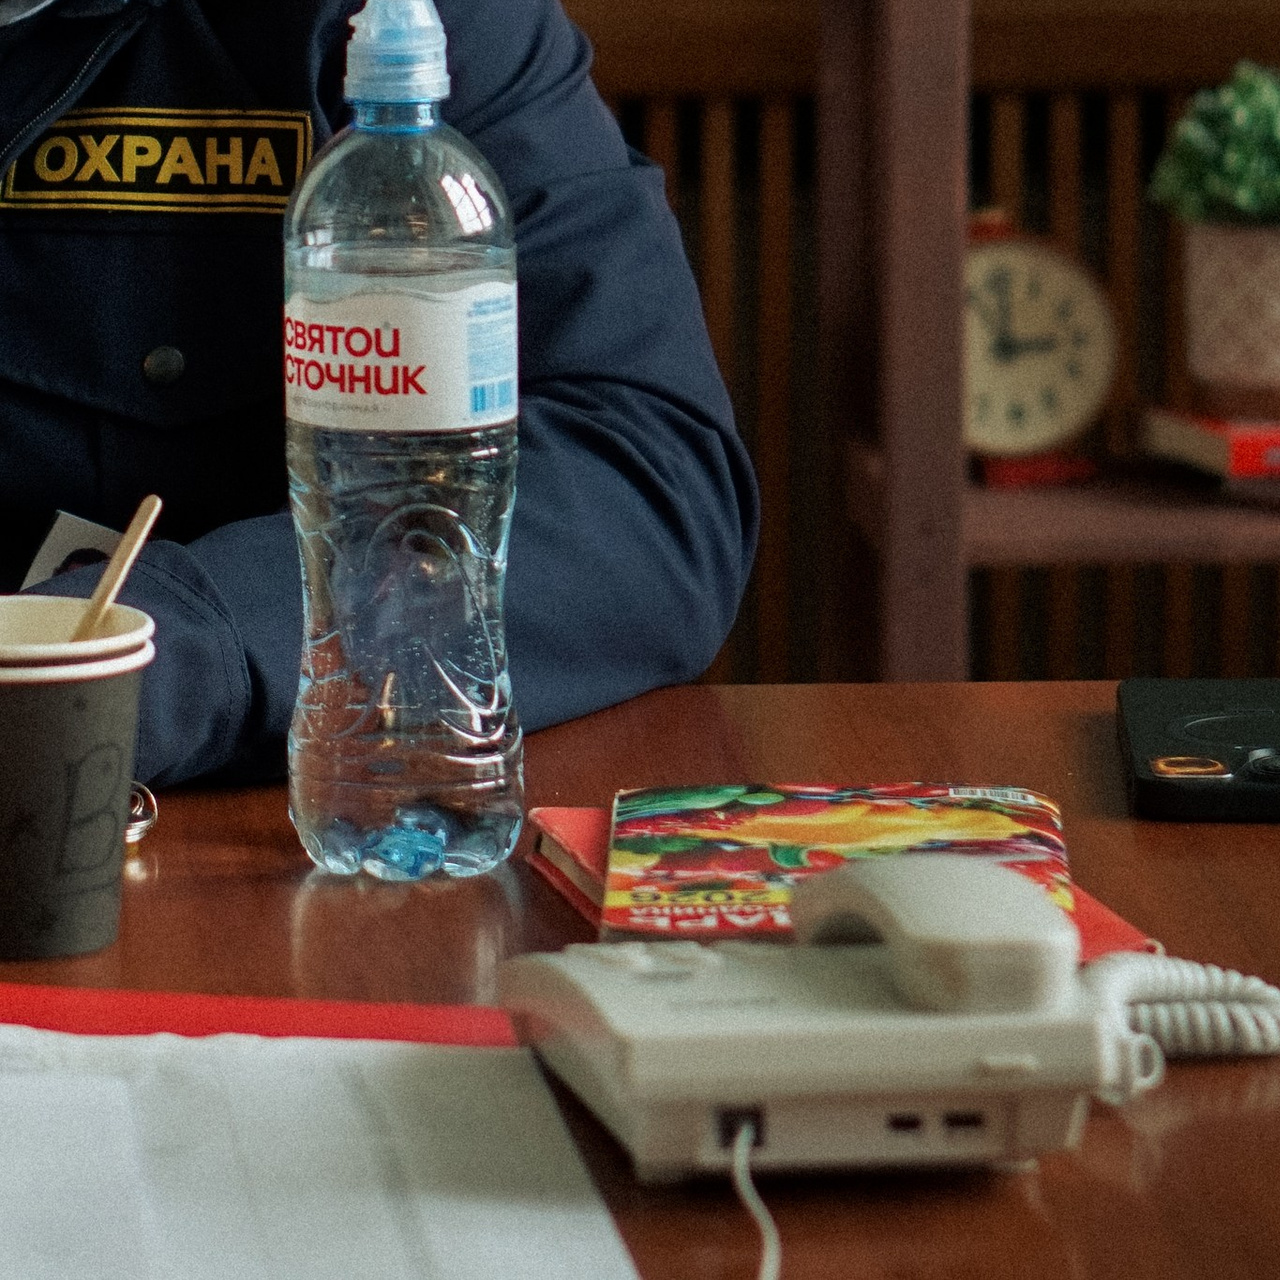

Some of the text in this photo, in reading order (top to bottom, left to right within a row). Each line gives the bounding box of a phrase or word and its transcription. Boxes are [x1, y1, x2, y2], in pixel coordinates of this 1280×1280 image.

[33, 133, 284, 186] ОХРАНА
[284, 316, 401, 358] СВЯТОЙ
[284, 353, 428, 396] СТОЧНИК
